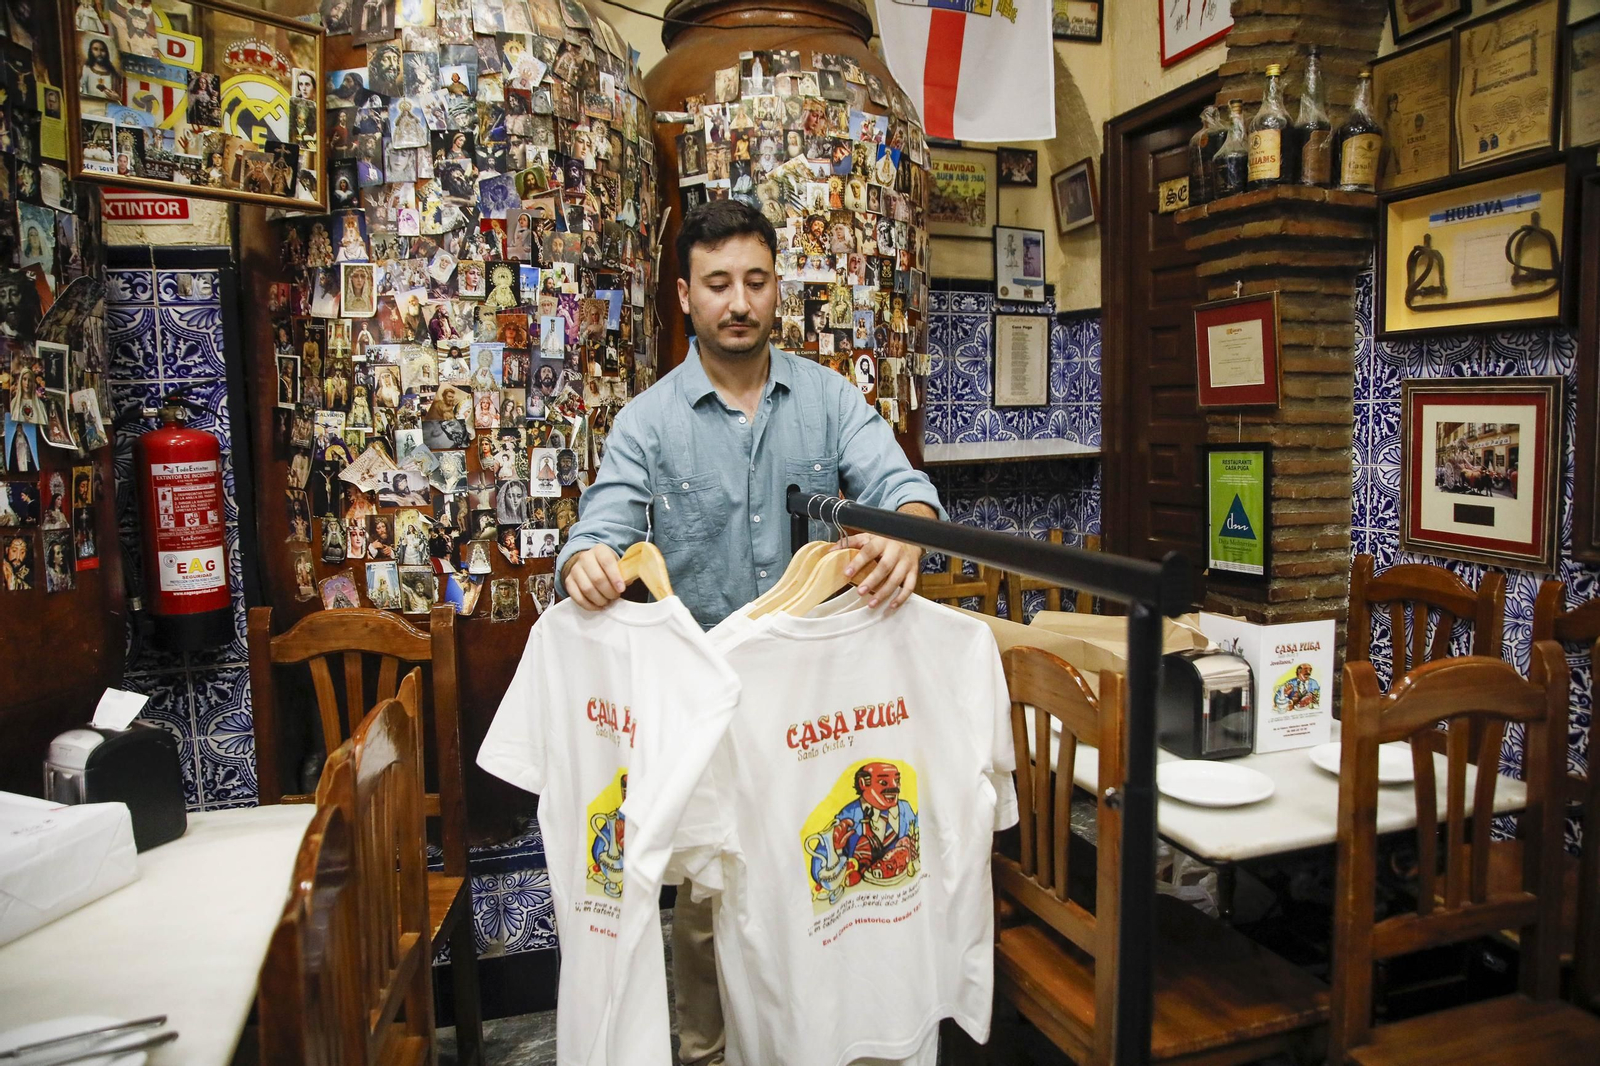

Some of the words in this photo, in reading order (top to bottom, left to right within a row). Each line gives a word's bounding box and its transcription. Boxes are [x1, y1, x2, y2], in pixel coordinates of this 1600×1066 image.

[943, 163, 976, 172] NAVIDAD
[936, 172, 954, 180] BUEN
[956, 172, 969, 182] AÑO
[104, 199, 181, 217] XTINTOR
[1444, 199, 1504, 222] HUELVA
[177, 558, 216, 574] EAG
[1275, 643, 1298, 655] CASA
[786, 710, 850, 750] CASA
[853, 696, 910, 731] PUGA
[798, 748, 820, 762] Santo
[848, 736, 854, 747] 7
[880, 893, 894, 901] vino
[822, 936, 832, 946] En
[893, 911, 912, 923] desde
